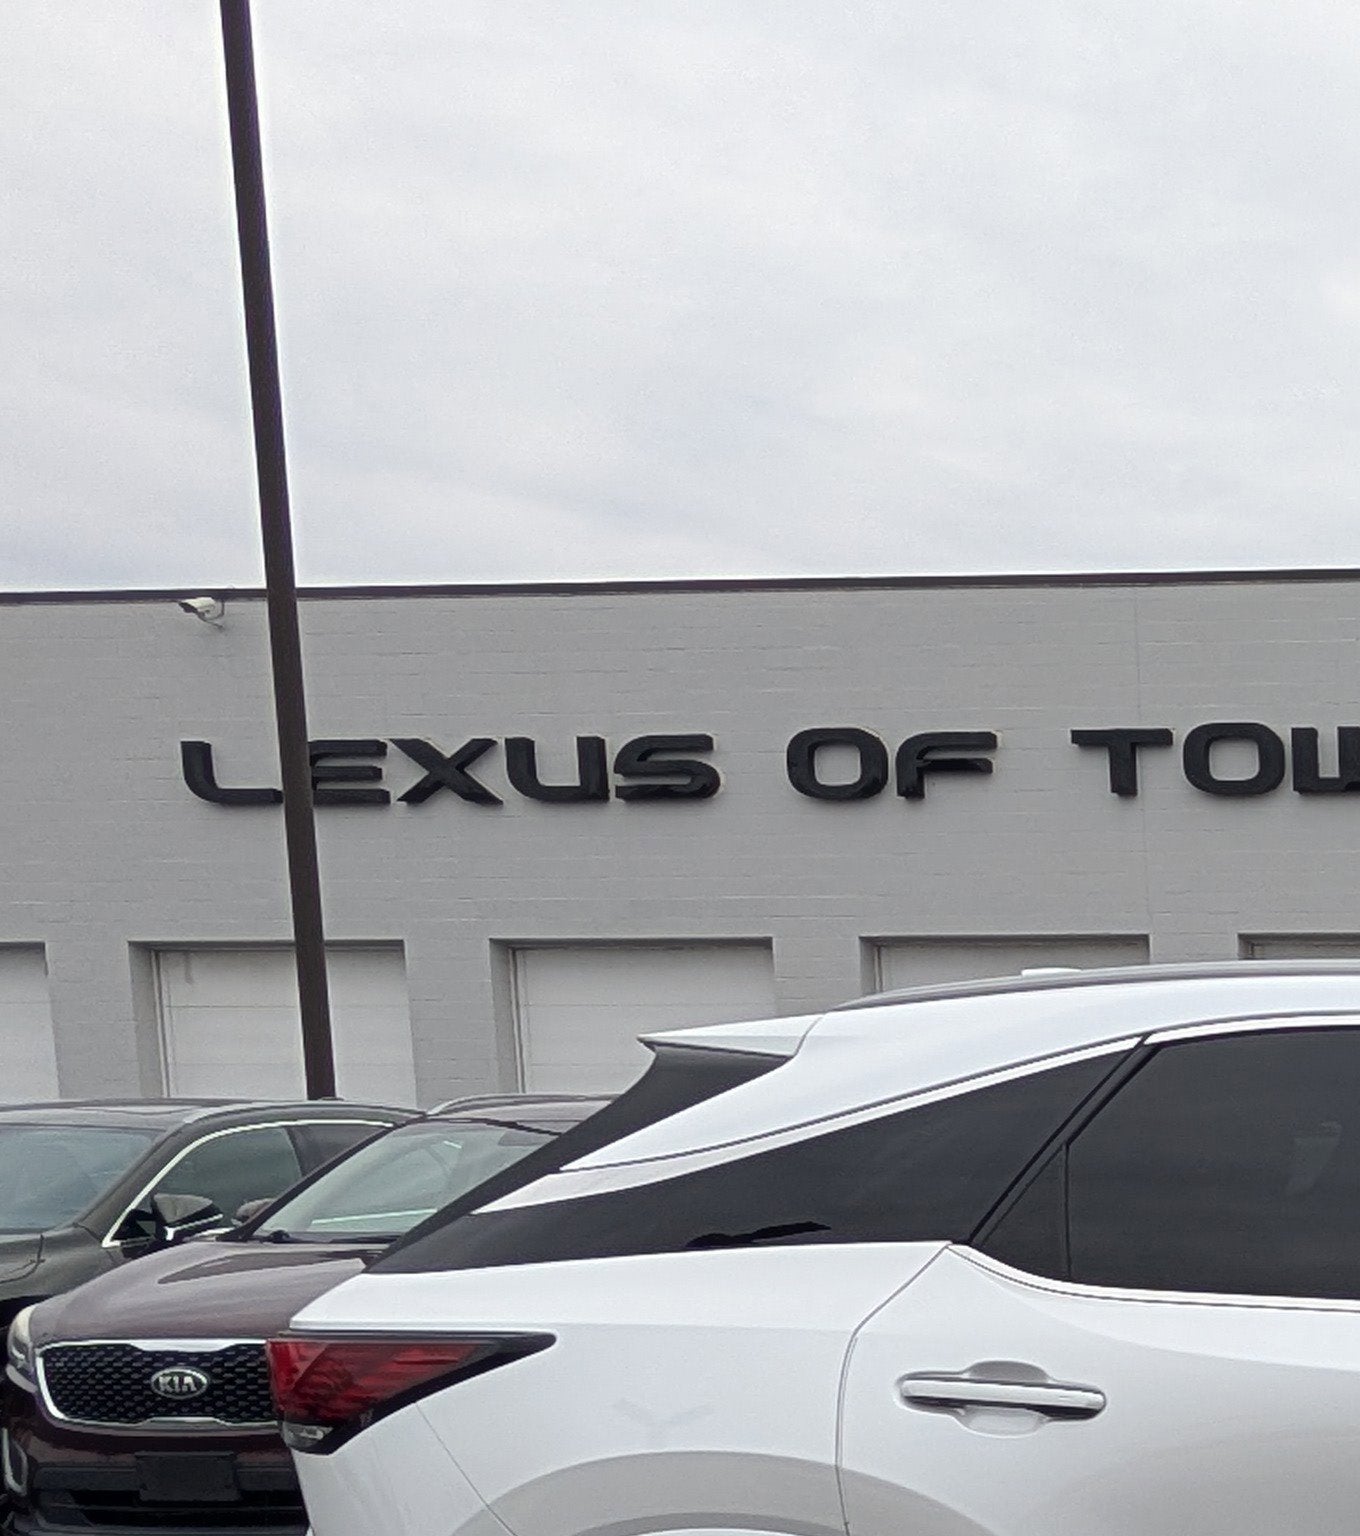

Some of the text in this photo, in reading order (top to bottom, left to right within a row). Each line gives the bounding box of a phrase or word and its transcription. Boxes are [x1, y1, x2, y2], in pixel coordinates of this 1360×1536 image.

[181, 734, 722, 804] LEXUS
[786, 727, 997, 799] OF
[158, 1374, 198, 1393] KIA
